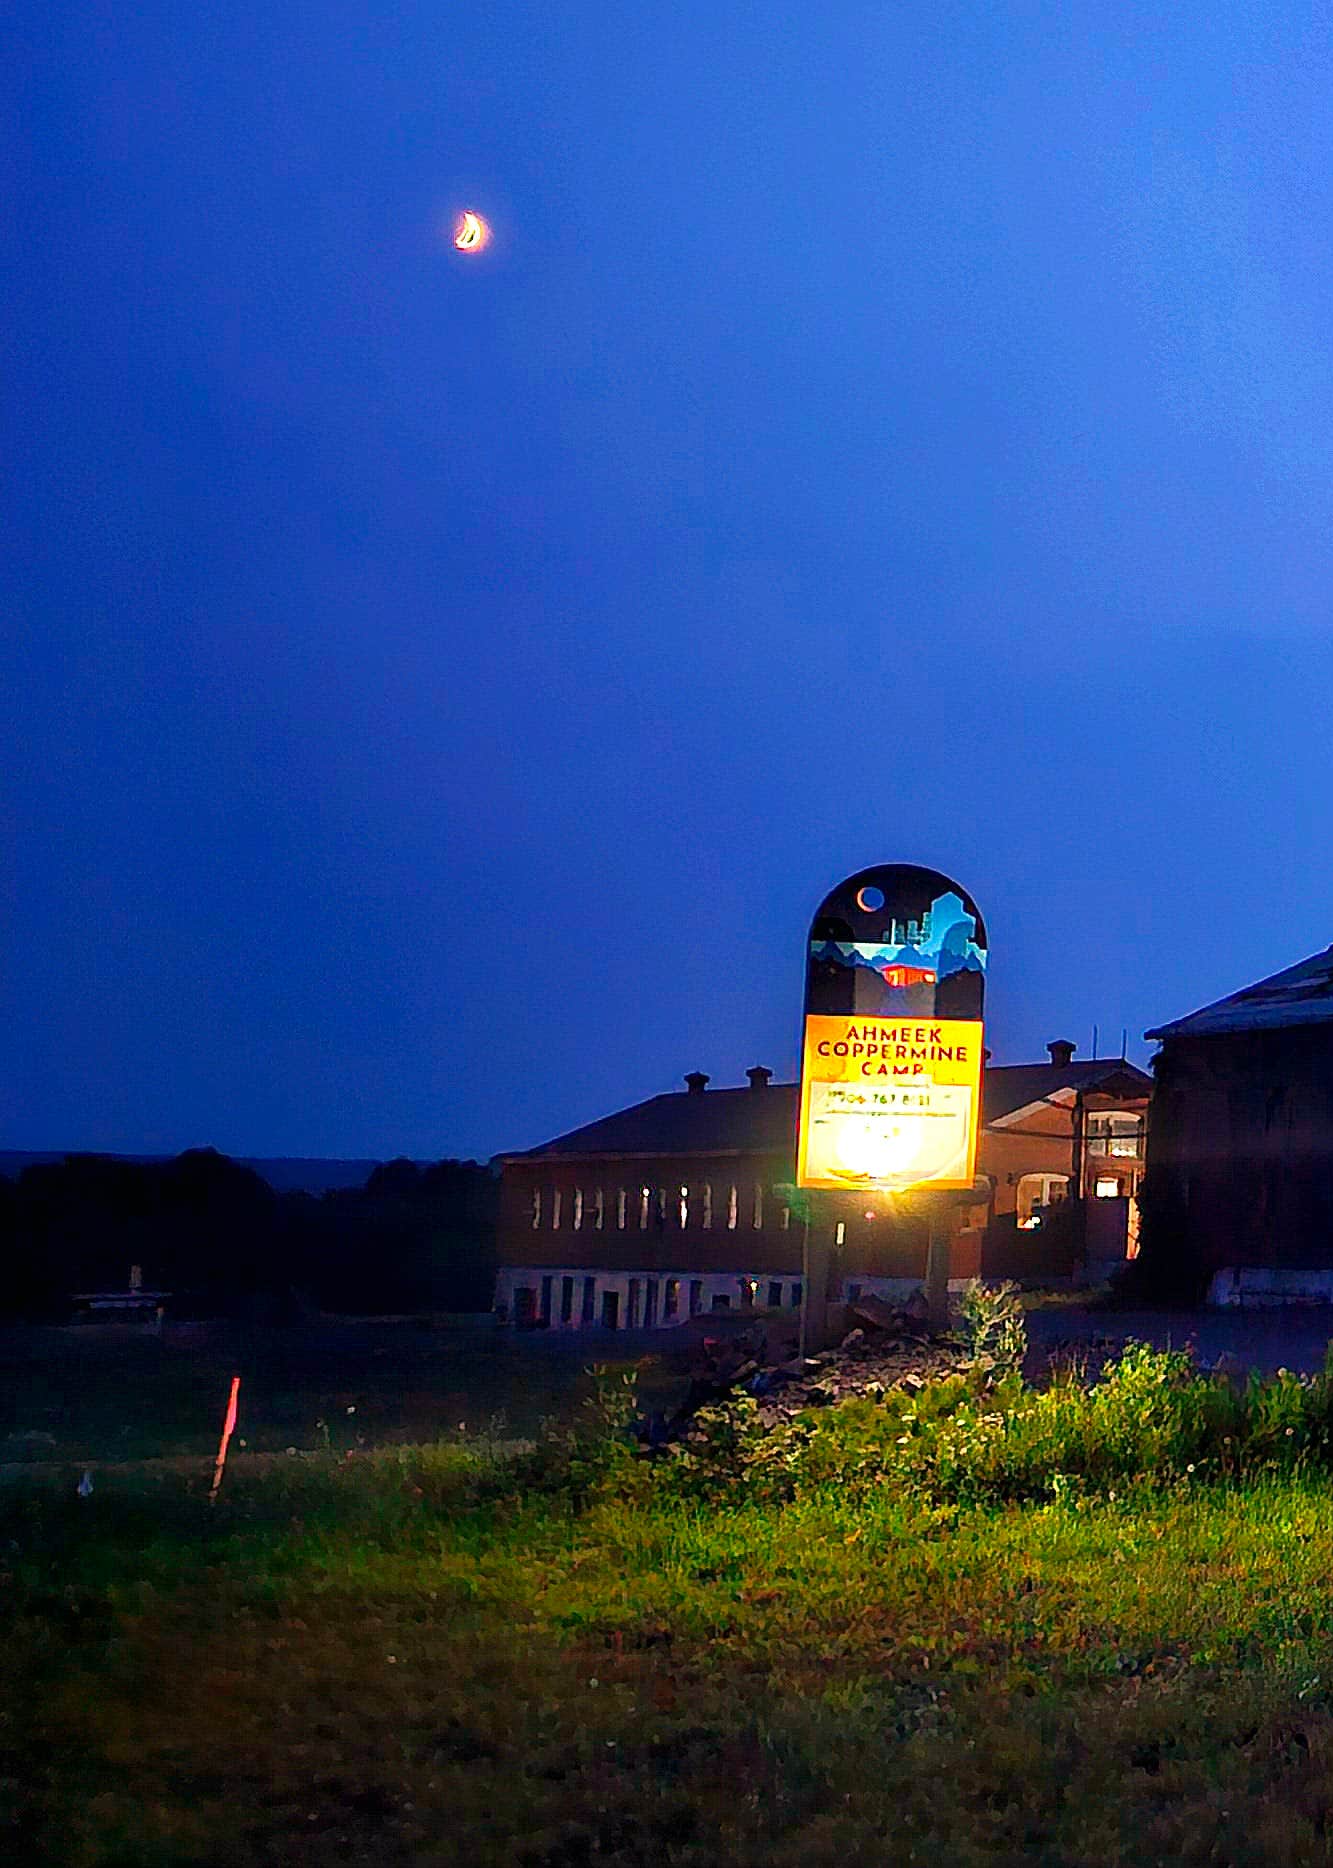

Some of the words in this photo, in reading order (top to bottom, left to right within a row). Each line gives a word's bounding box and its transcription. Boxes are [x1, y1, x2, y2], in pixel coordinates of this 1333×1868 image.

[847, 1026, 942, 1043] AHMEEK
[818, 1041, 968, 1062] COPPERMINE
[861, 1061, 924, 1075] CAMP
